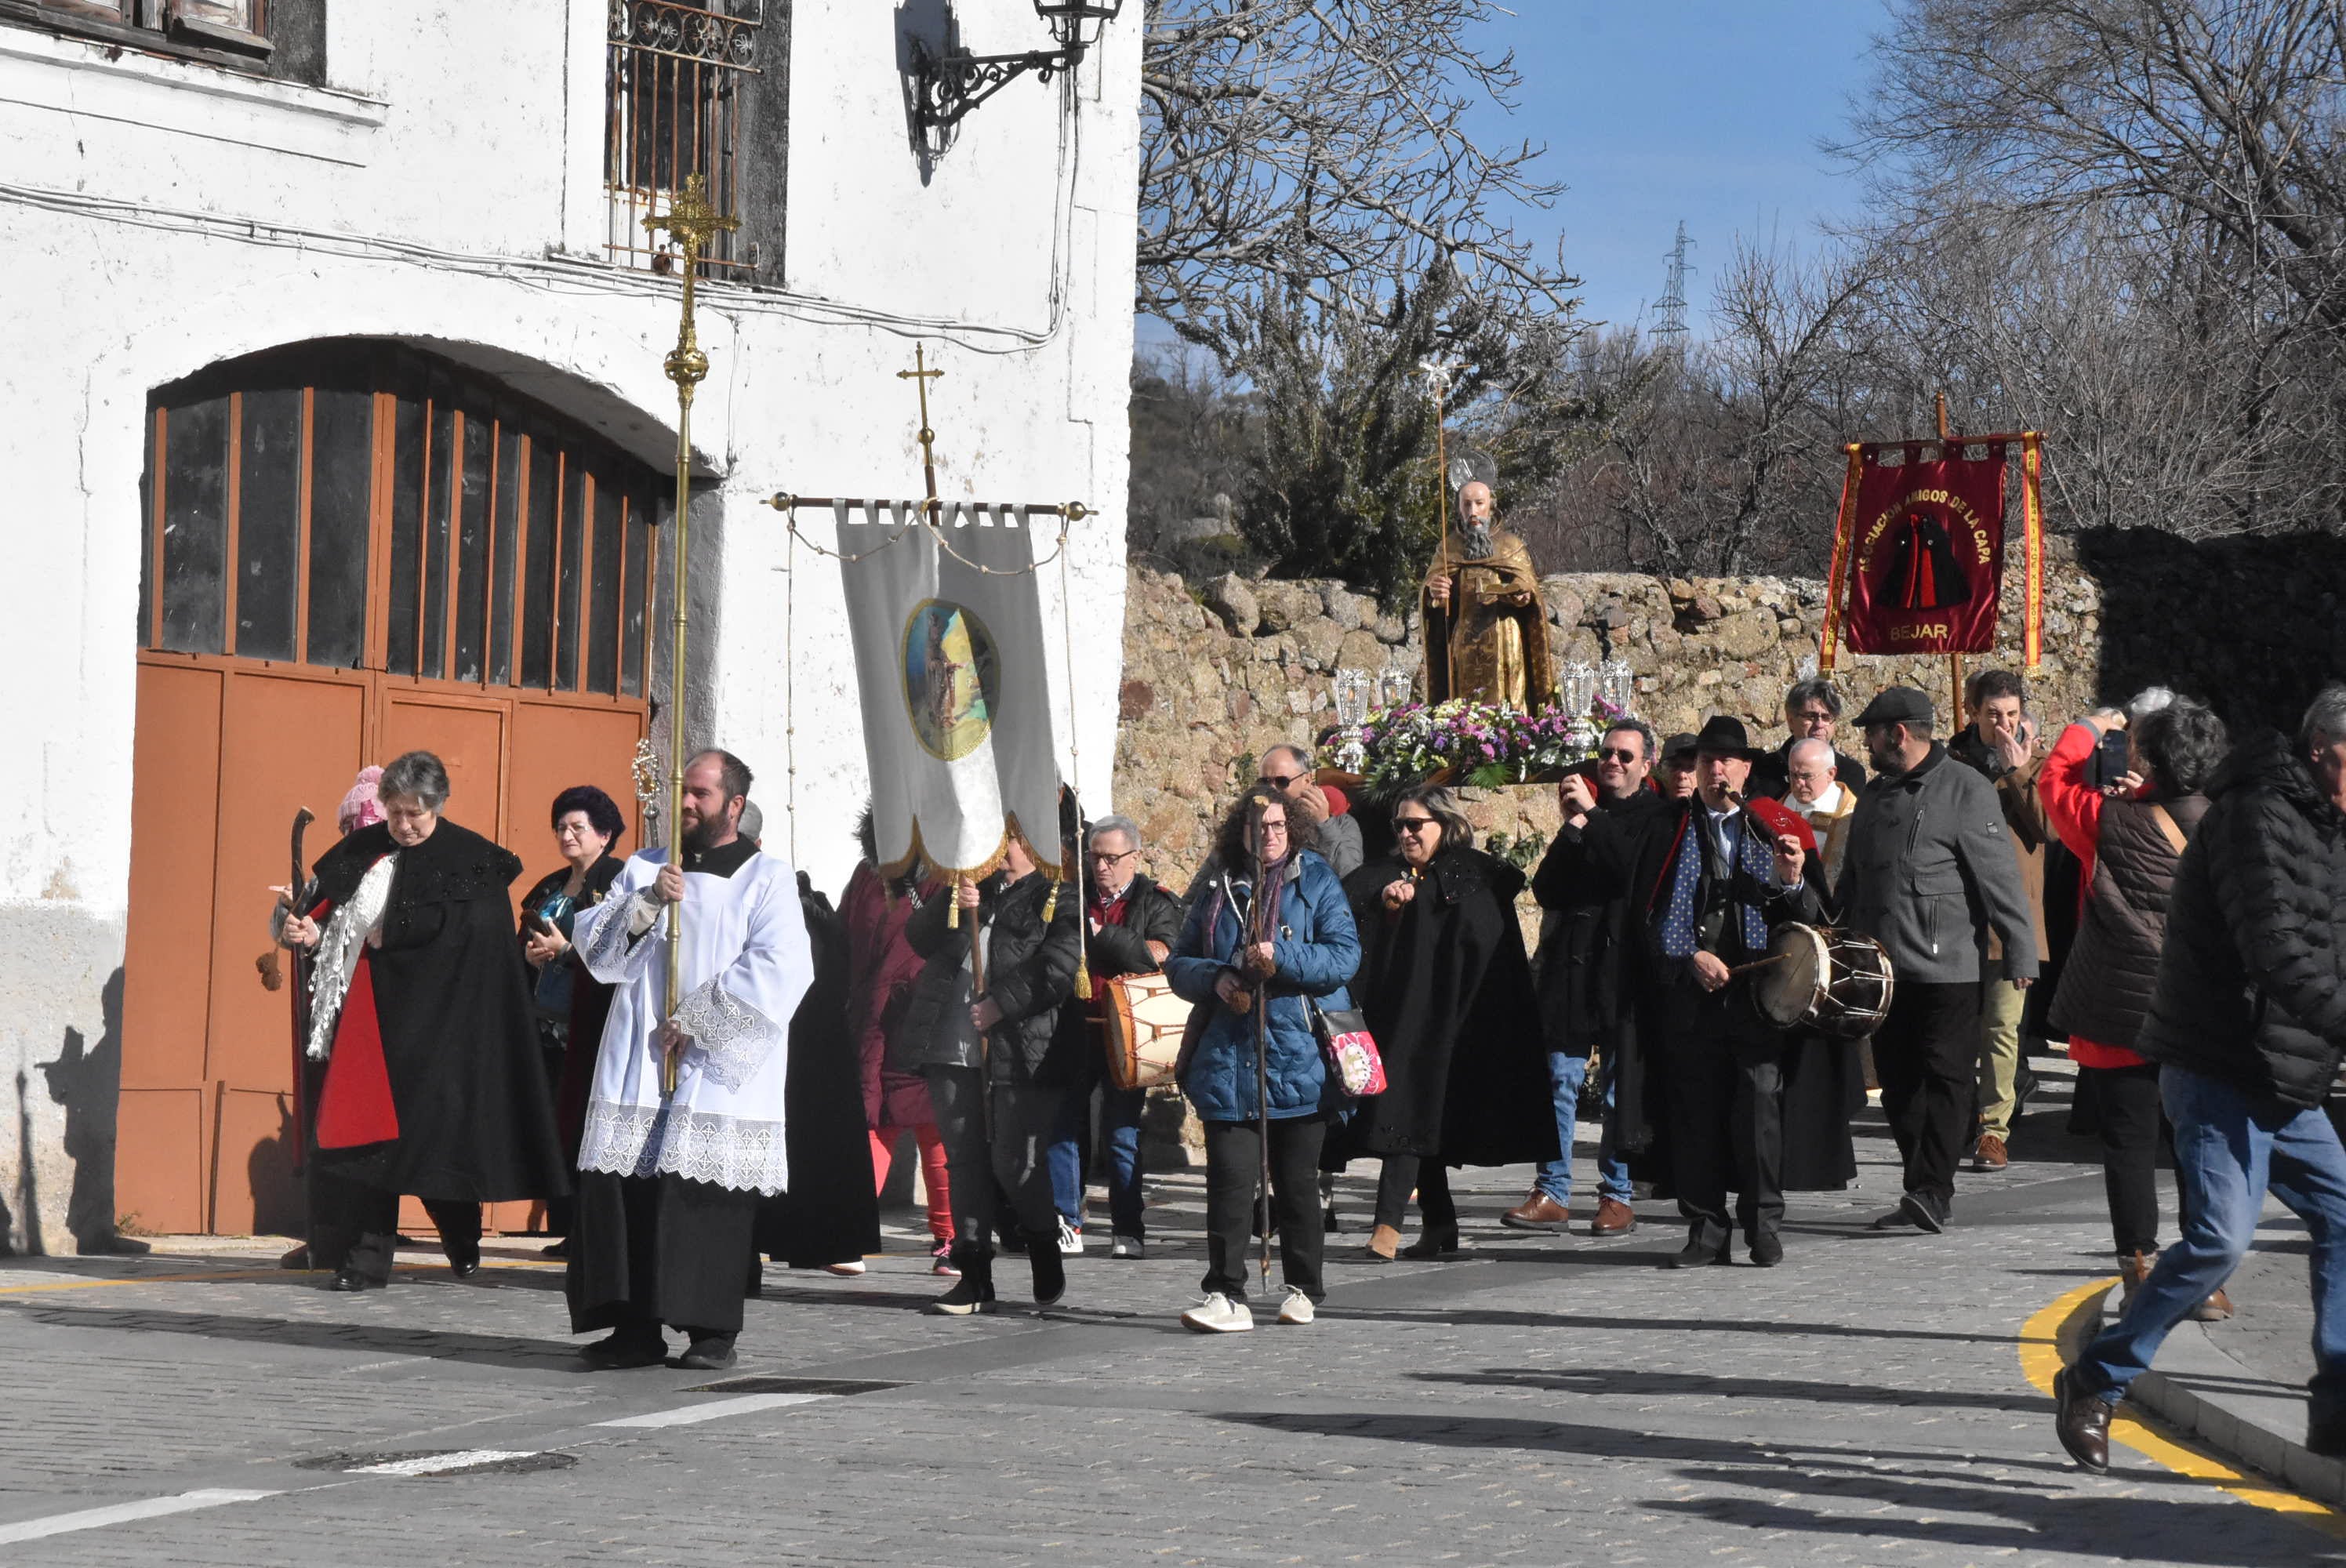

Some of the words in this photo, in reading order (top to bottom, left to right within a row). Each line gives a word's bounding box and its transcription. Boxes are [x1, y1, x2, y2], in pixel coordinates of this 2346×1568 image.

[1905, 489, 1948, 506] AMIGOS
[1949, 496, 1966, 514] DE
[1963, 510, 1980, 529] LA
[1974, 530, 1991, 564] CAPA
[1890, 624, 1948, 641] BEJAR
